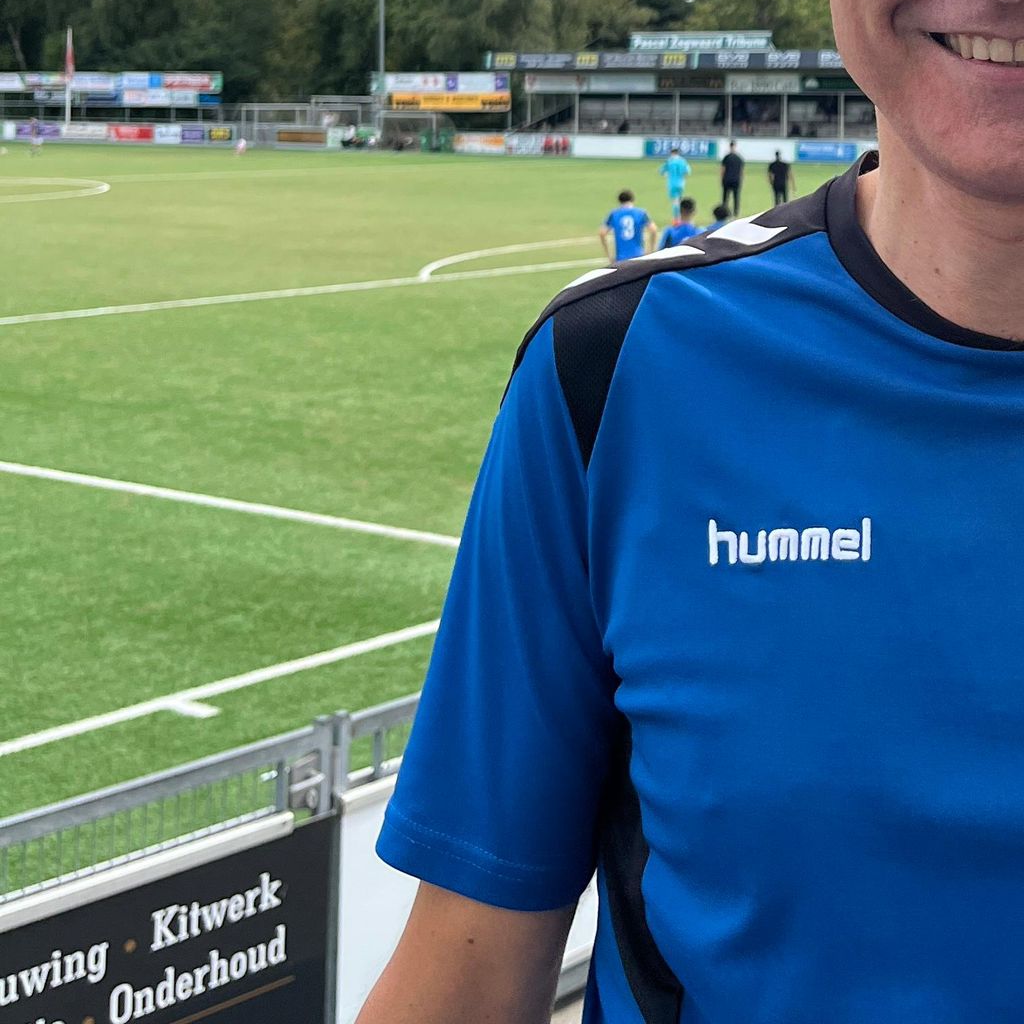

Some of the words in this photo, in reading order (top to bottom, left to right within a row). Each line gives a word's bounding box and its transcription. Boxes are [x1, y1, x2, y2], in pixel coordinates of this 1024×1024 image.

[708, 517, 871, 566] hummel
[150, 872, 284, 953] Kitwerk
[108, 923, 288, 1024] Onderhoud
